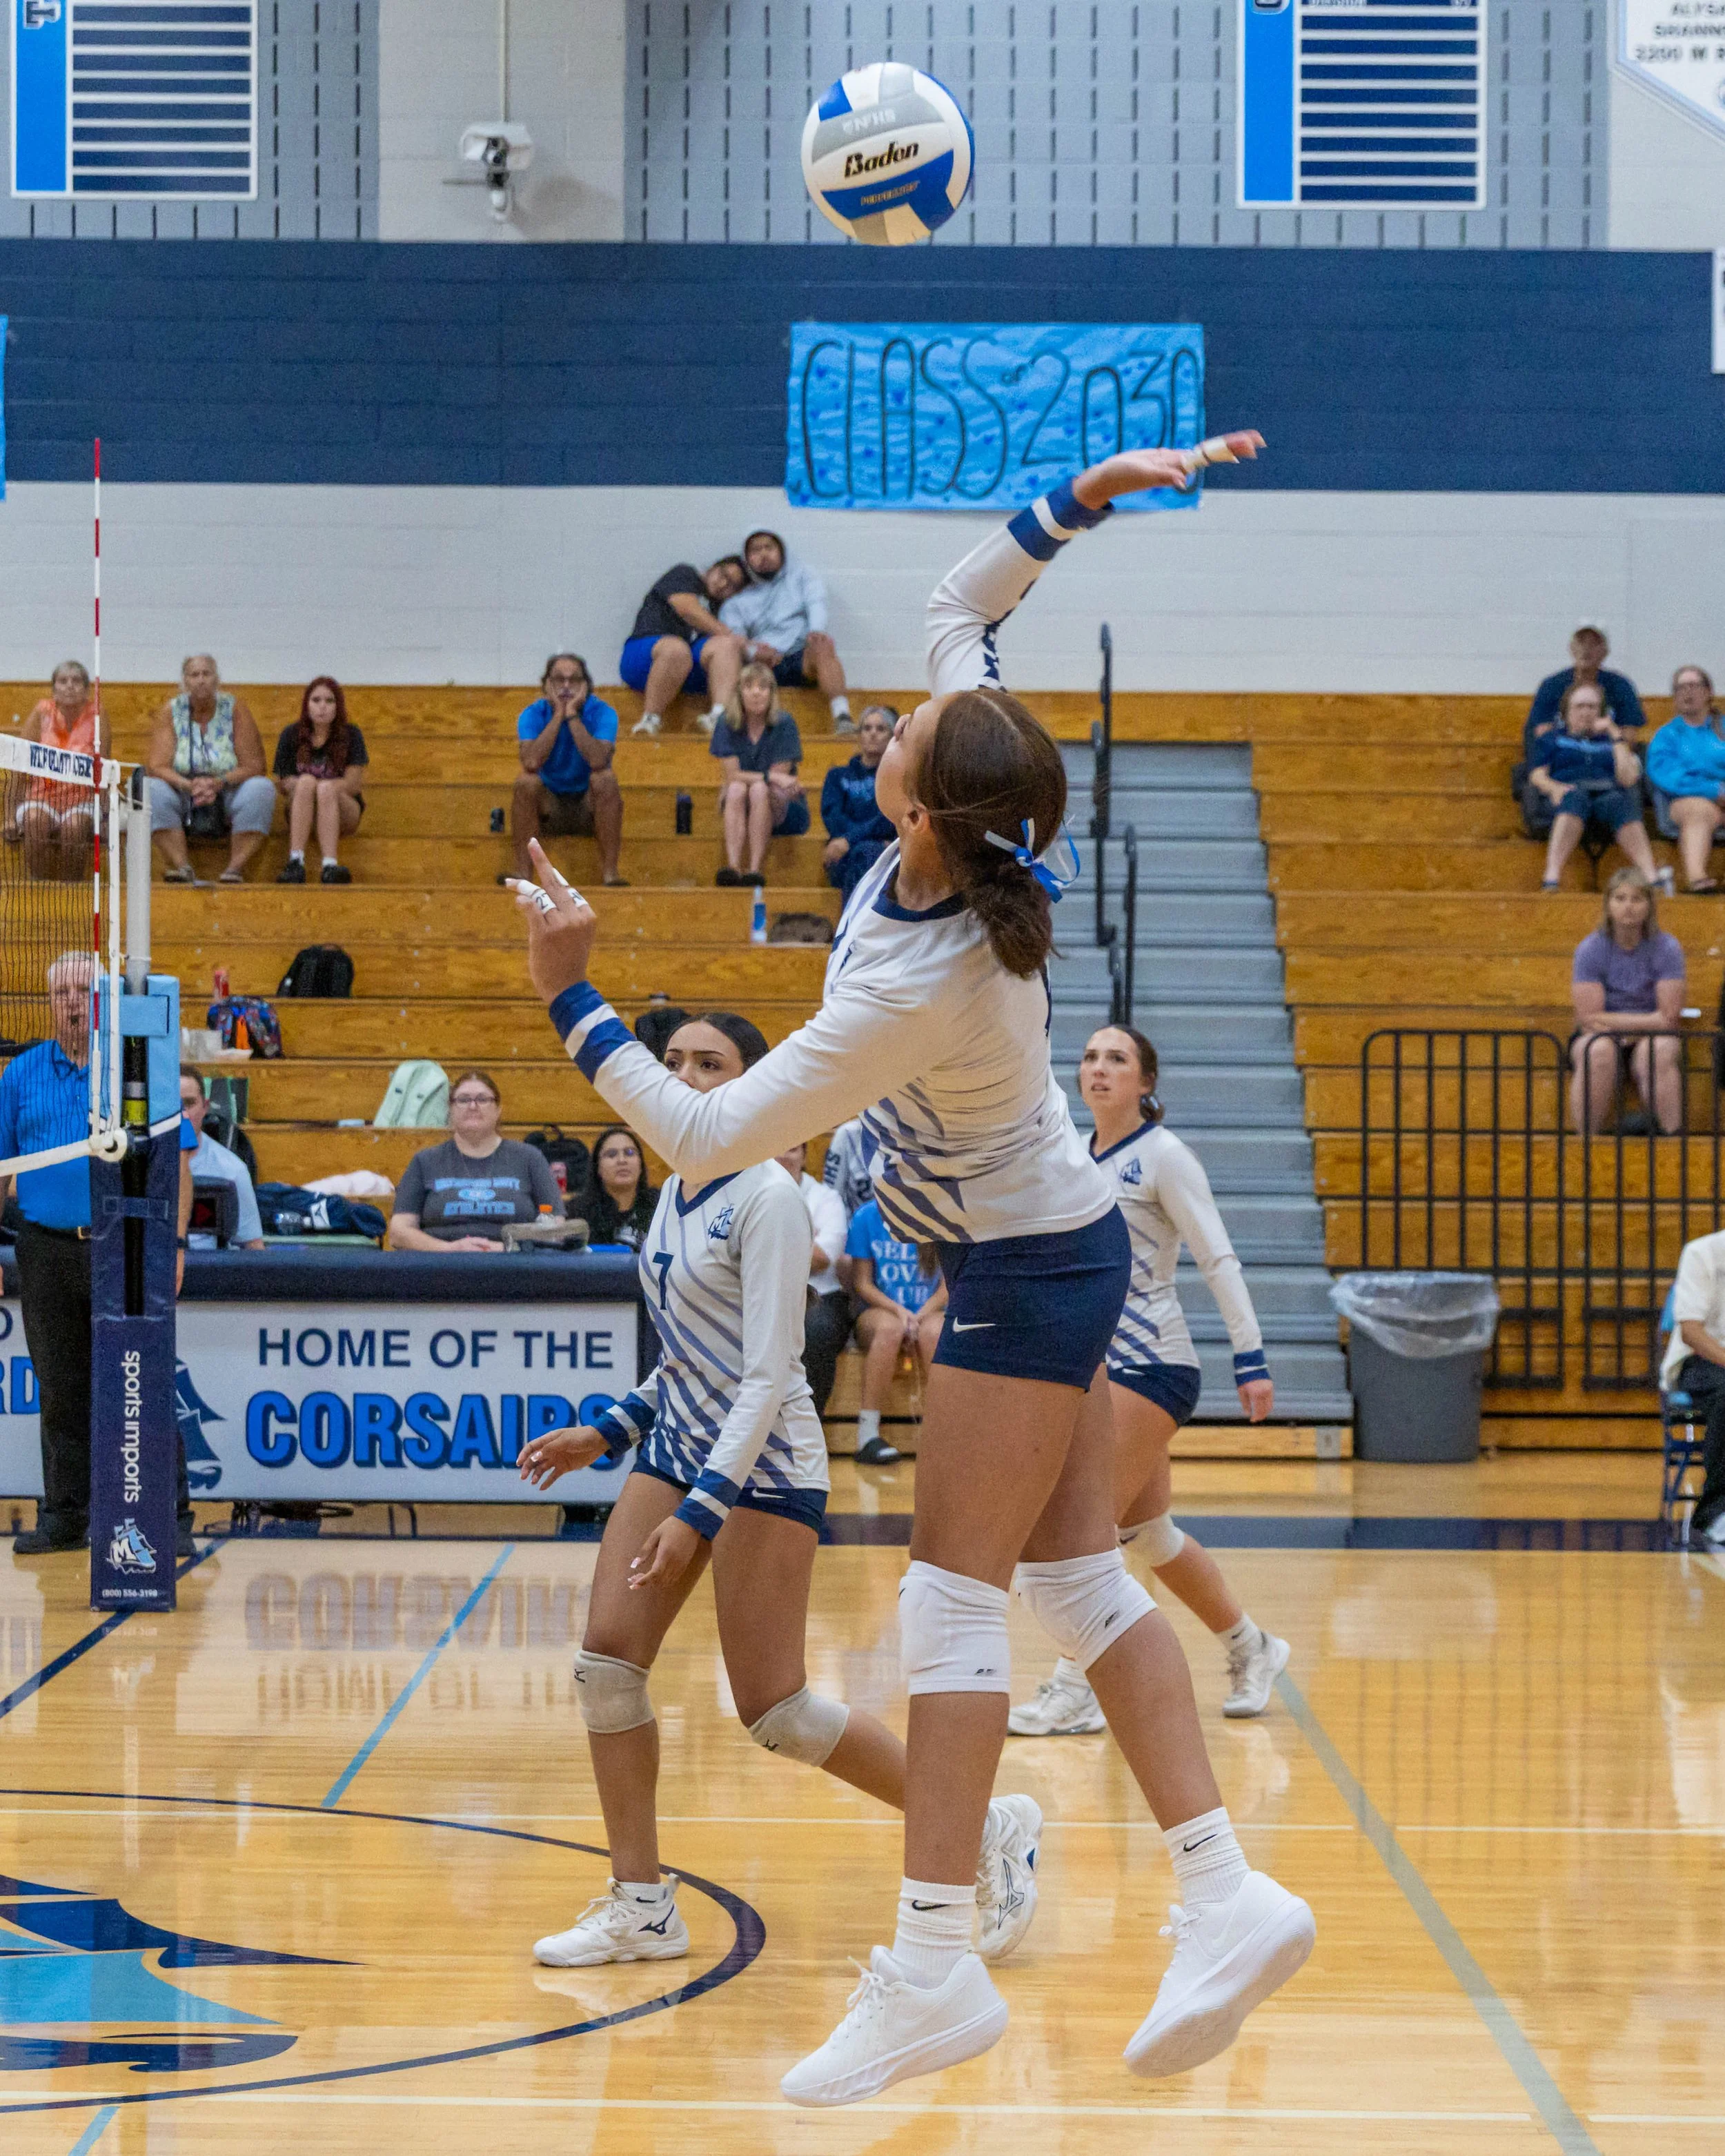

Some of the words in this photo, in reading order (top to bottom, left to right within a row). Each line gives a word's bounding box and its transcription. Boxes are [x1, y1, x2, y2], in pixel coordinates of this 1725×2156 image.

[844, 141, 920, 178] Baden
[871, 1240, 917, 1260] SEL
[652, 1251, 674, 1310] 7
[258, 1328, 411, 1367] HOME
[429, 1329, 497, 1367] OF
[513, 1331, 613, 1369] THE
[121, 1350, 143, 1418] sports
[120, 1421, 143, 1503] imports
